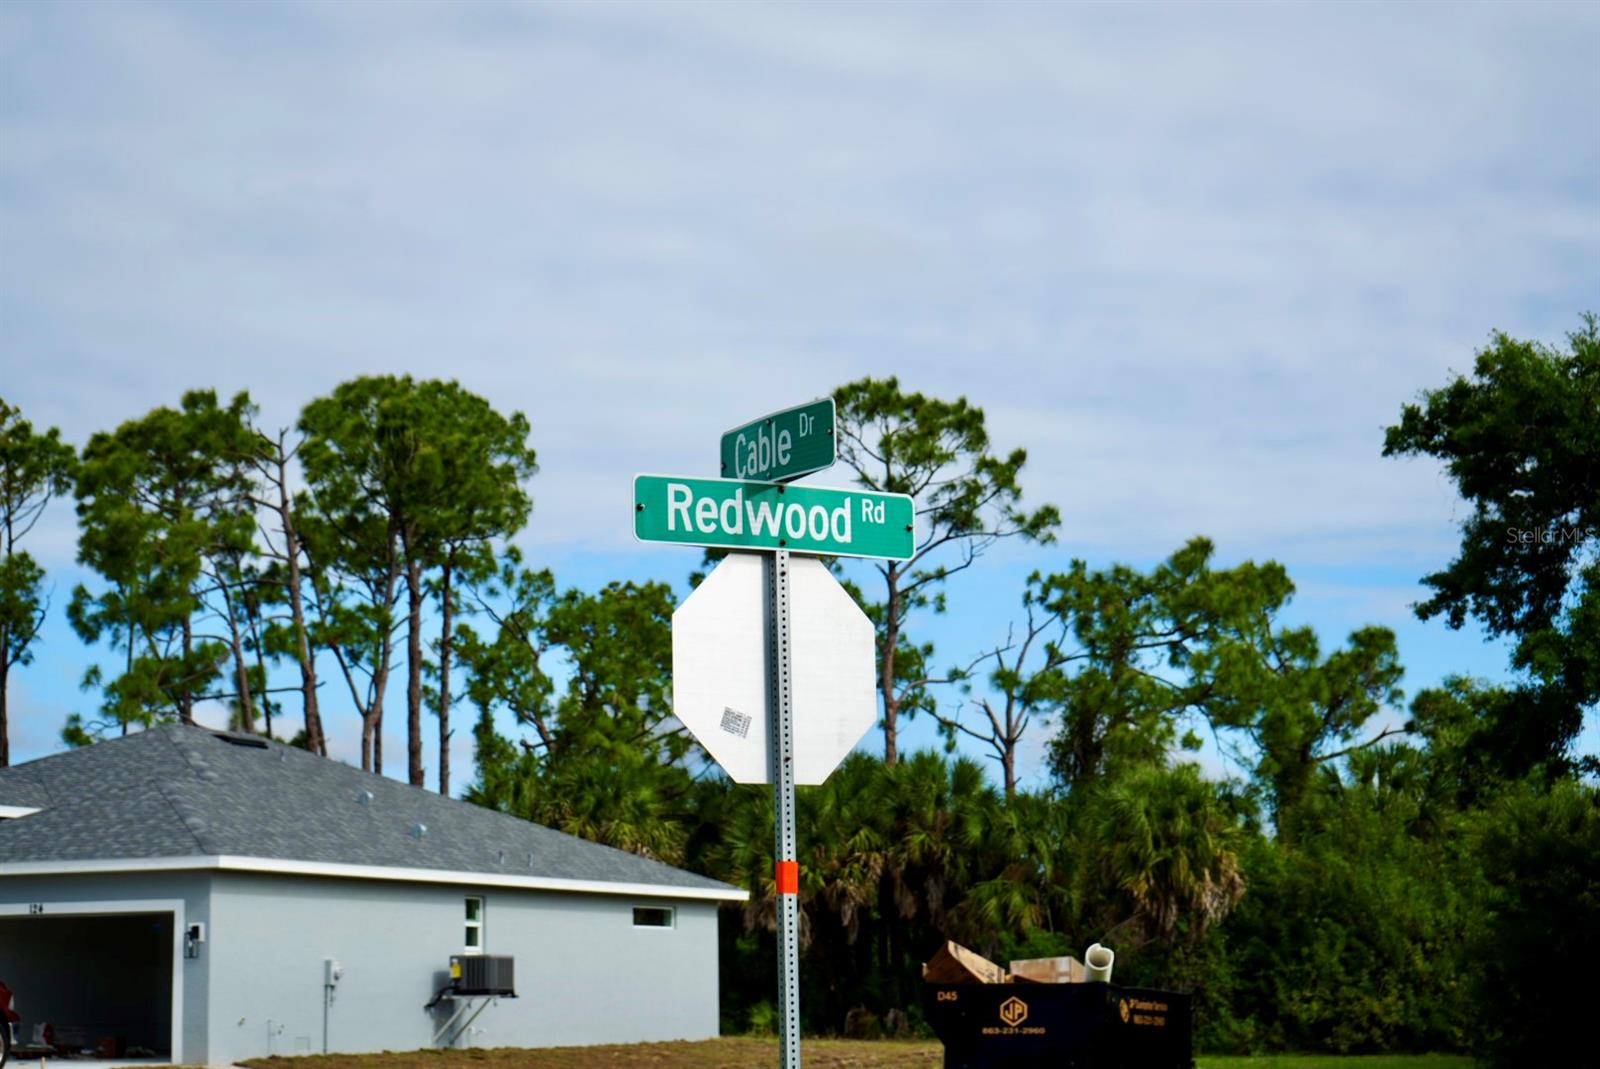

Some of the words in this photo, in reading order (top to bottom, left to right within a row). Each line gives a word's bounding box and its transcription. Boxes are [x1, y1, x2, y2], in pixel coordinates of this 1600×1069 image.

[735, 423, 791, 478] Cable
[799, 412, 815, 437] Dr
[667, 484, 851, 543] Redwood
[862, 498, 885, 524] Rd
[937, 991, 958, 1001] D45
[1004, 1003, 1024, 1020] JP
